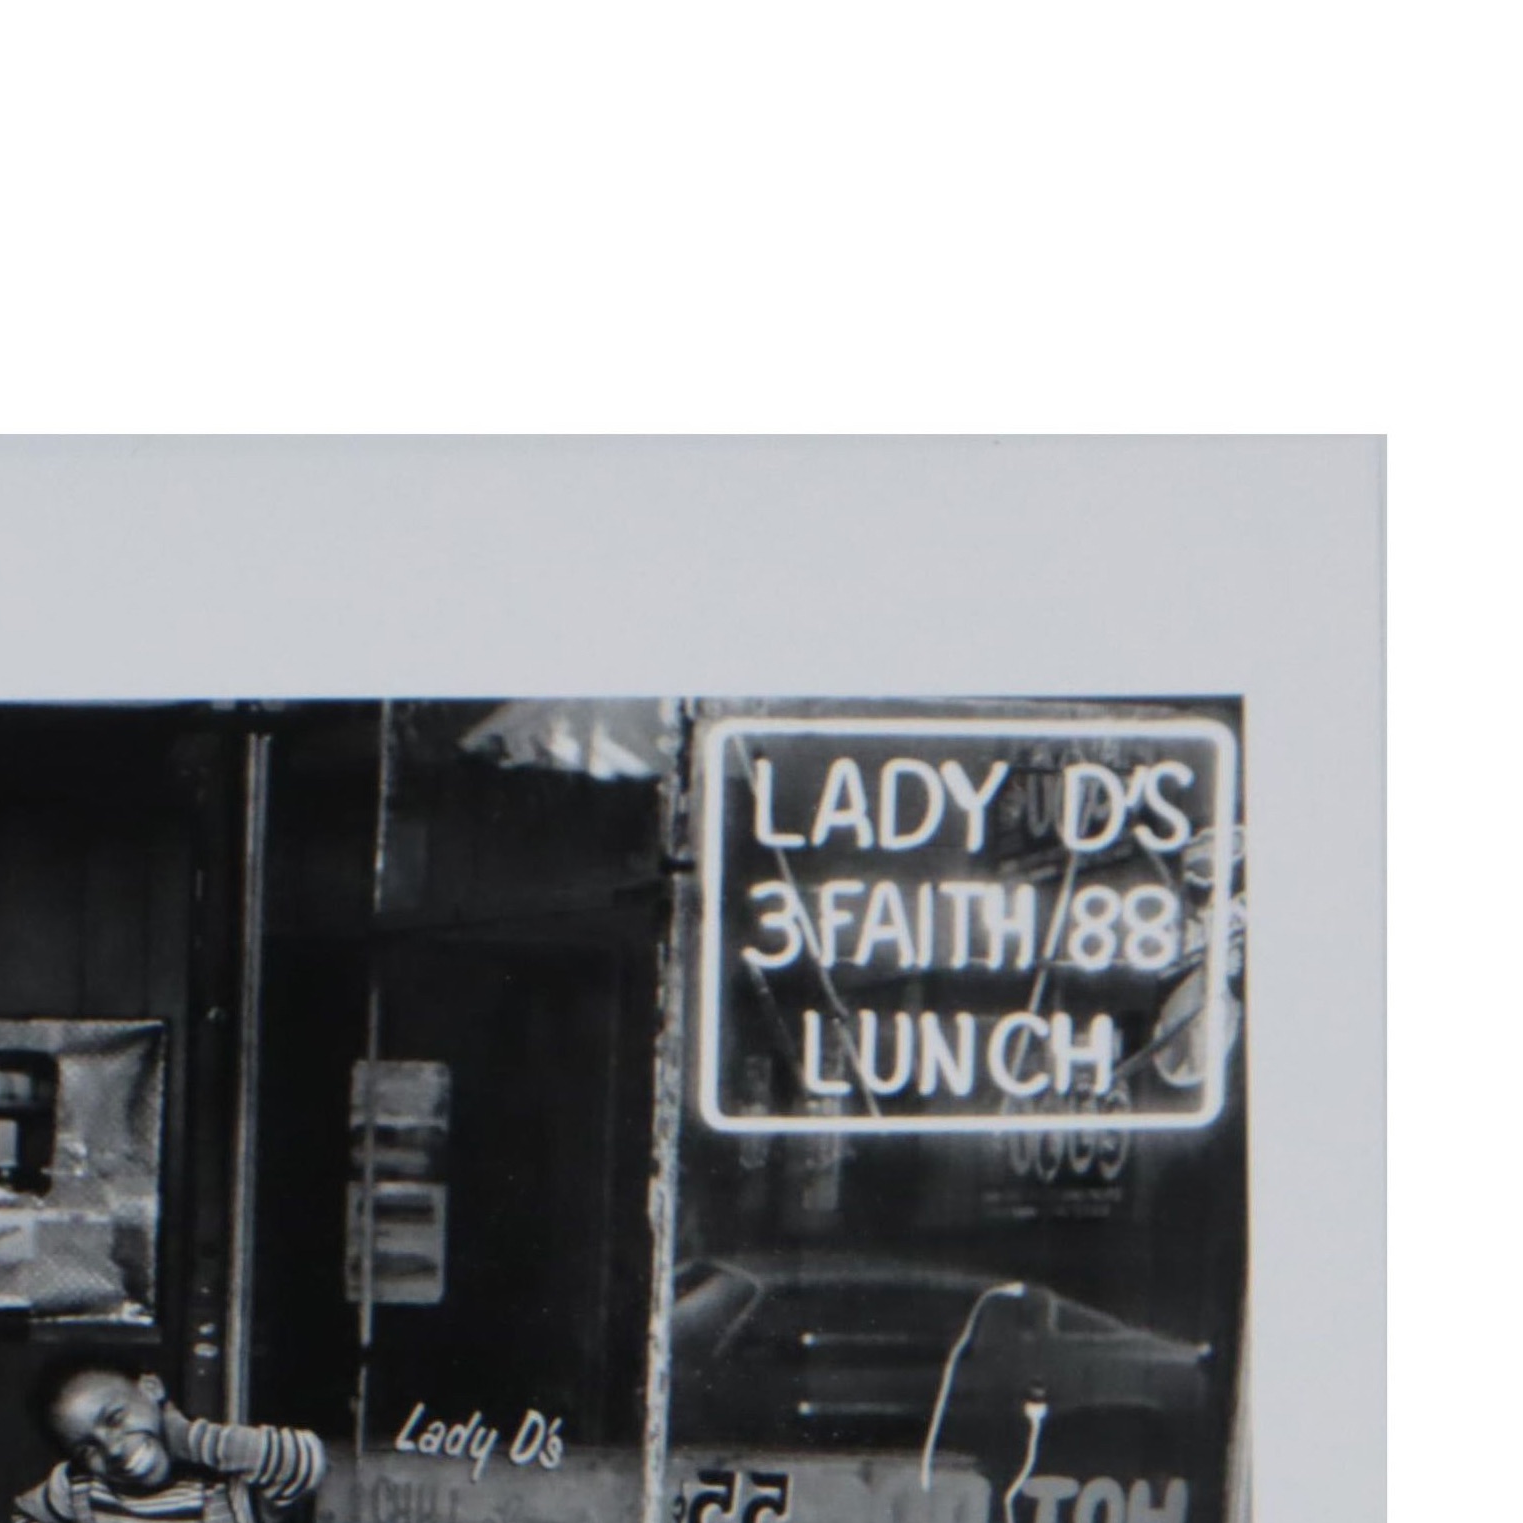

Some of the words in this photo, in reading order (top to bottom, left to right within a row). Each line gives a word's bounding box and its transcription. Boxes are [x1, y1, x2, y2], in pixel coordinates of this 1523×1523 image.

[755, 757, 1009, 853] LADY
[1063, 762, 1195, 853] D'S
[1069, 884, 1177, 971] 88
[803, 1009, 1114, 1097] LUNCH
[395, 1402, 498, 1482] Lady
[509, 1410, 564, 1469] D's
